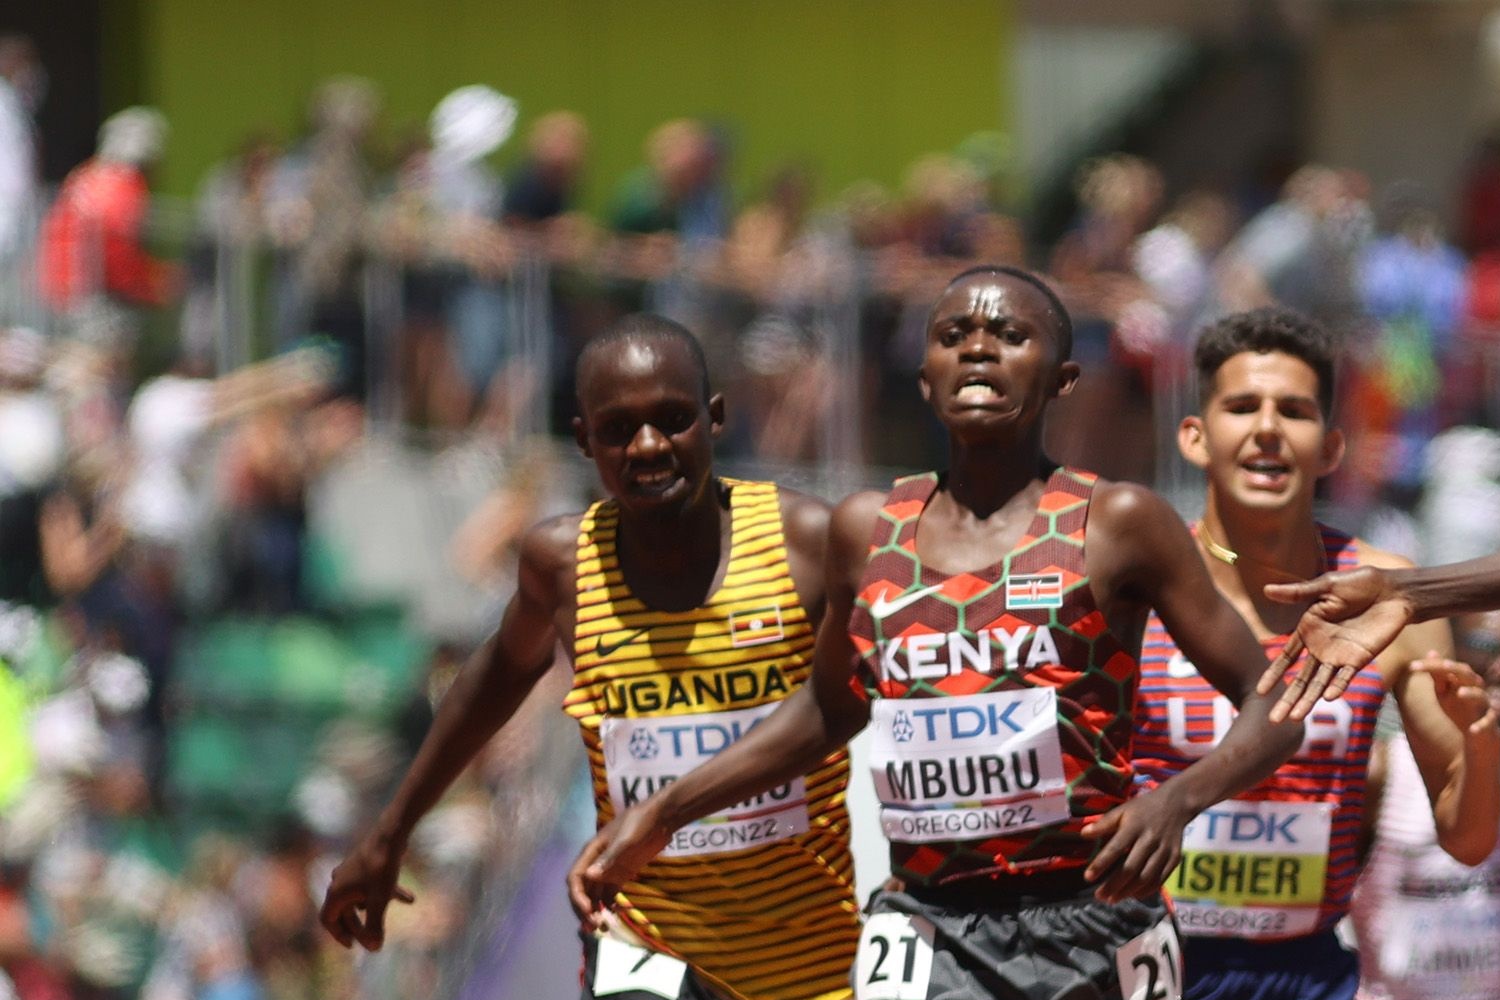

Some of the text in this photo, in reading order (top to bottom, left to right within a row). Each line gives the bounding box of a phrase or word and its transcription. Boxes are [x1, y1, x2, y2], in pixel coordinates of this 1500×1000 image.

[876, 625, 1061, 681] KENYA
[603, 664, 788, 714] UGANDA
[912, 701, 1025, 741] TDK
[1167, 694, 1353, 758] UA
[886, 749, 1041, 801] MBURU
[668, 819, 778, 850] EGON22
[900, 805, 1036, 836] OREGON22
[1204, 811, 1301, 843] TDK
[1177, 853, 1301, 896] ISHER
[1179, 908, 1288, 931] REGON22
[868, 934, 920, 984] 21
